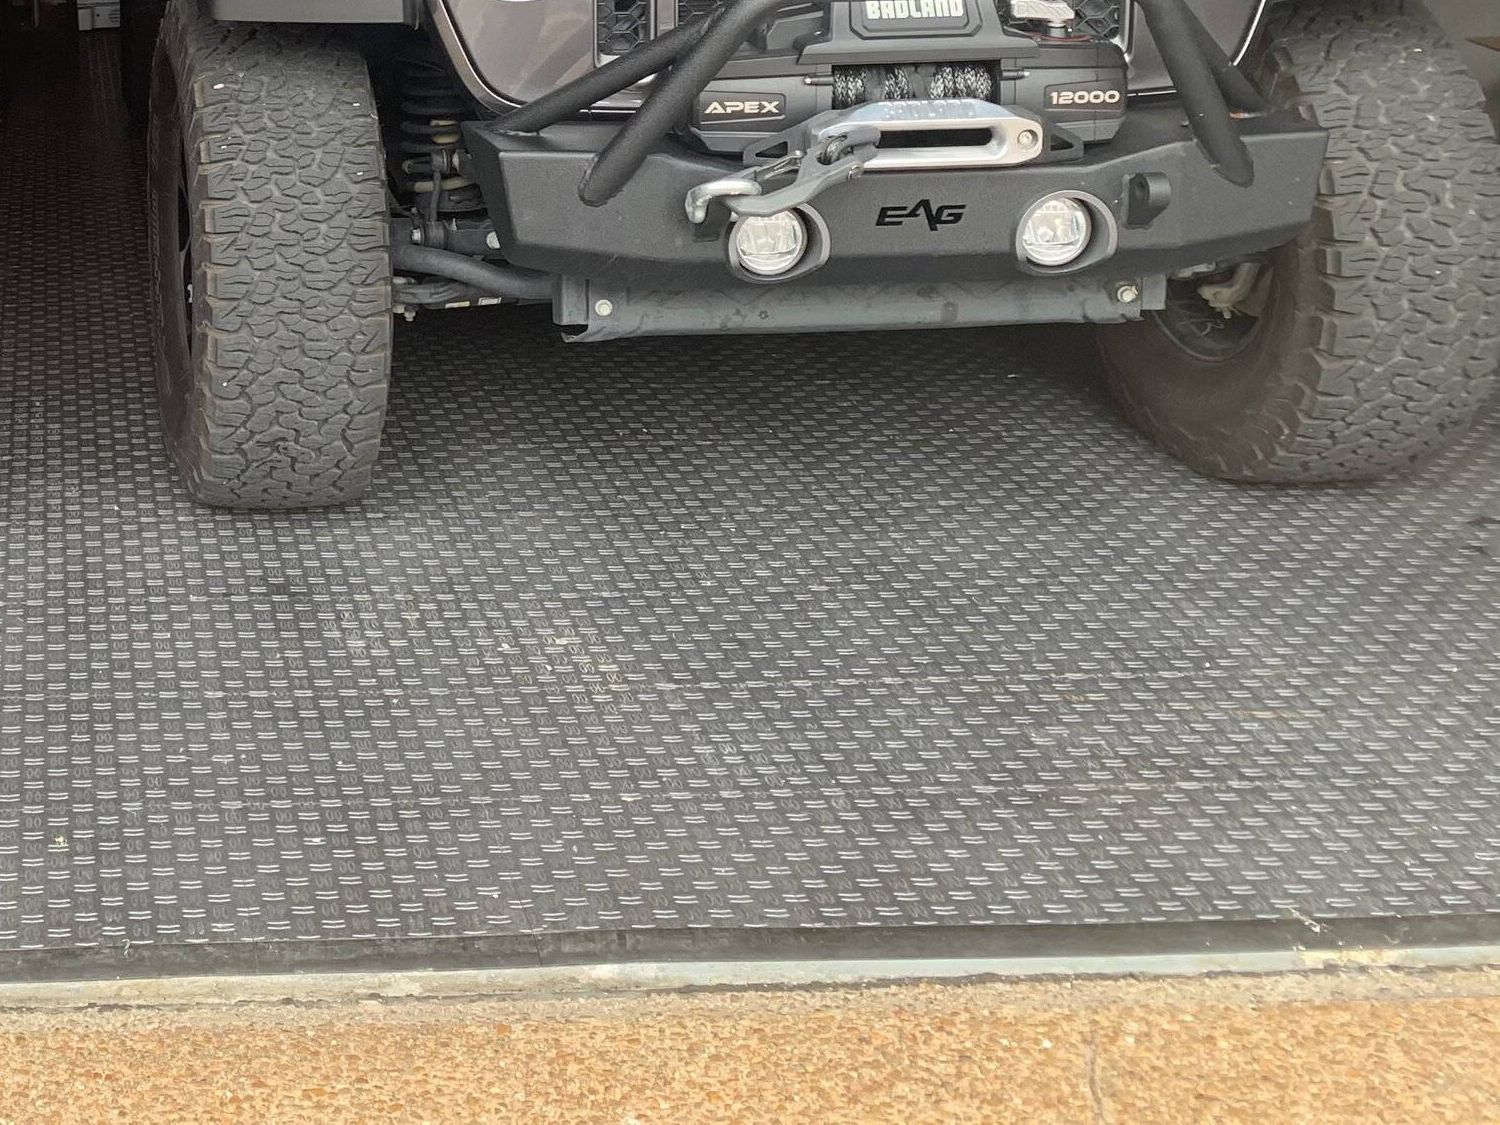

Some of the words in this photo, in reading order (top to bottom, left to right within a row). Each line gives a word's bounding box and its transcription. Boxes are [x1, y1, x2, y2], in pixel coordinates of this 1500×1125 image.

[1050, 89, 1120, 105] 12000
[703, 101, 780, 114] APEX
[875, 198, 967, 231] EAG
